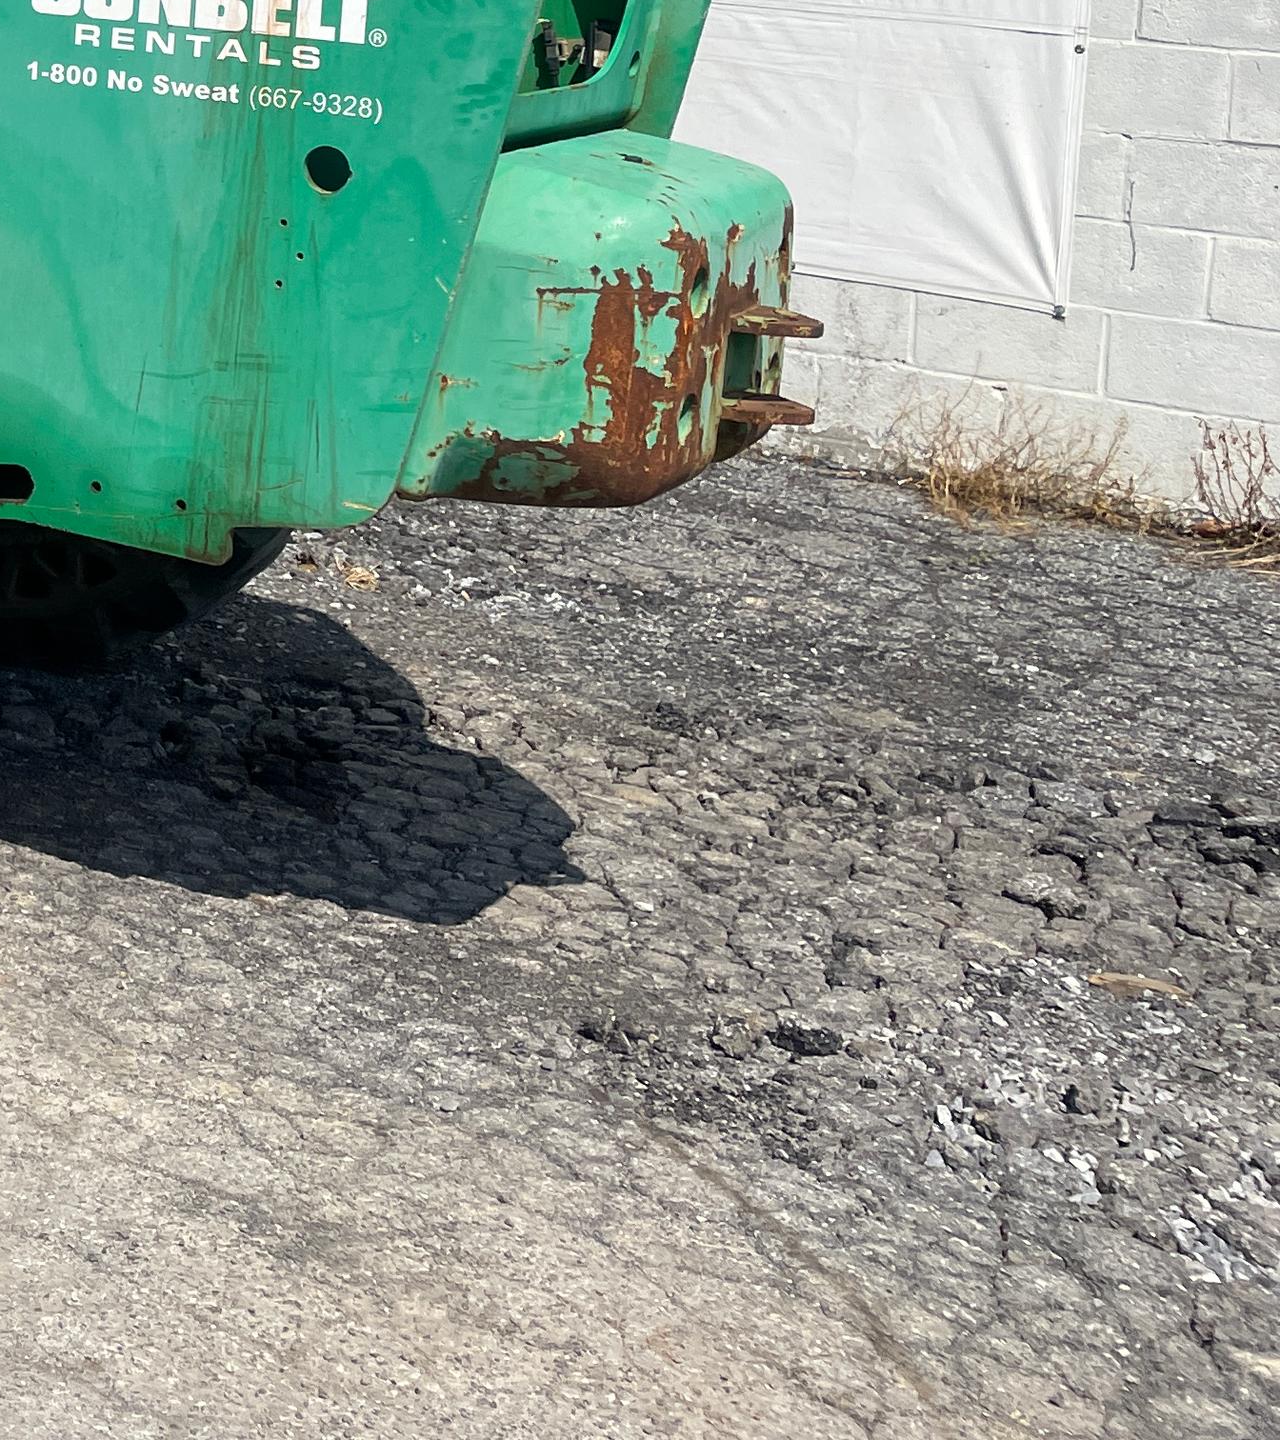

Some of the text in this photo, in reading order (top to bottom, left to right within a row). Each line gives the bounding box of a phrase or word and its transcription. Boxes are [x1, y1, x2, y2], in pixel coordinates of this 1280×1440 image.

[74, 23, 321, 70] RENTALS
[26, 61, 384, 125] 1-800 No Sweat (667-9328)
